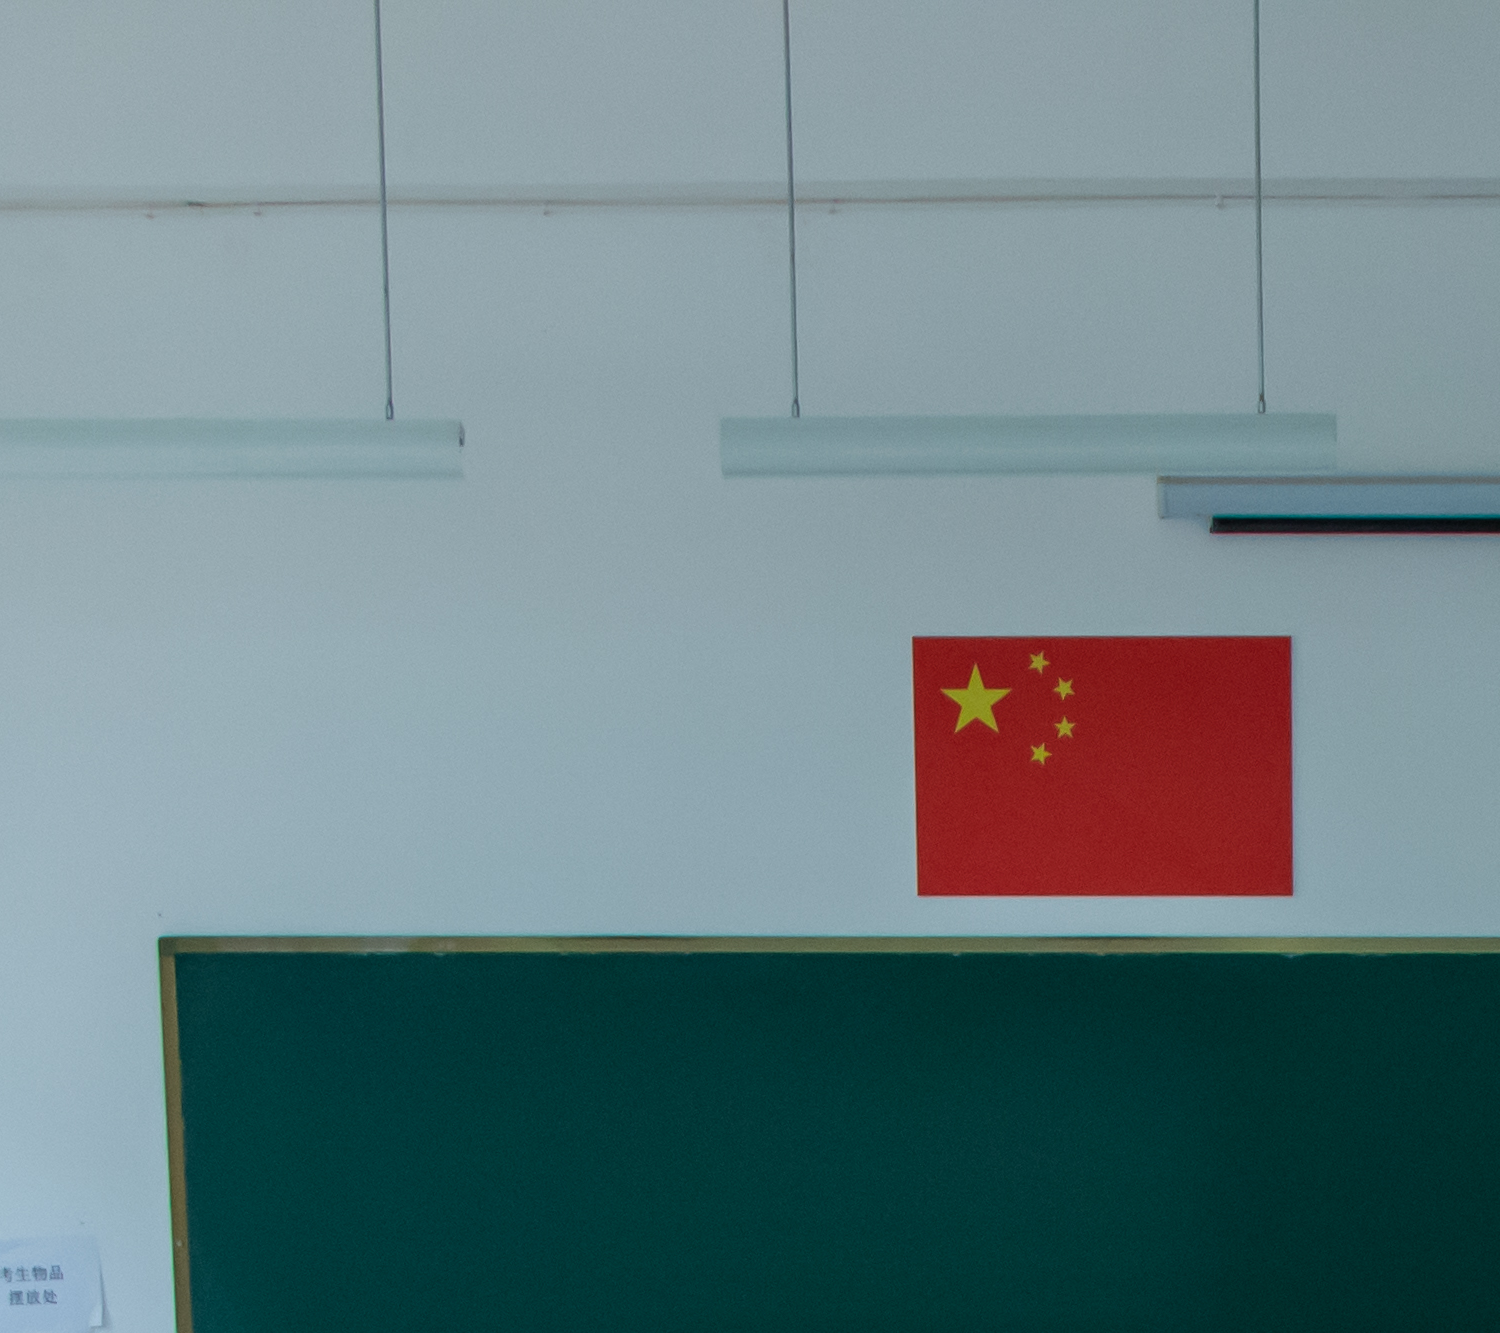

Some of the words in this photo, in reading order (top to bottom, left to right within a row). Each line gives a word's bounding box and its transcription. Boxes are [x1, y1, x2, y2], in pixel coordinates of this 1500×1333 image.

[0, 1264, 65, 1283] 考生物品
[9, 1288, 58, 1306] 摆放处
